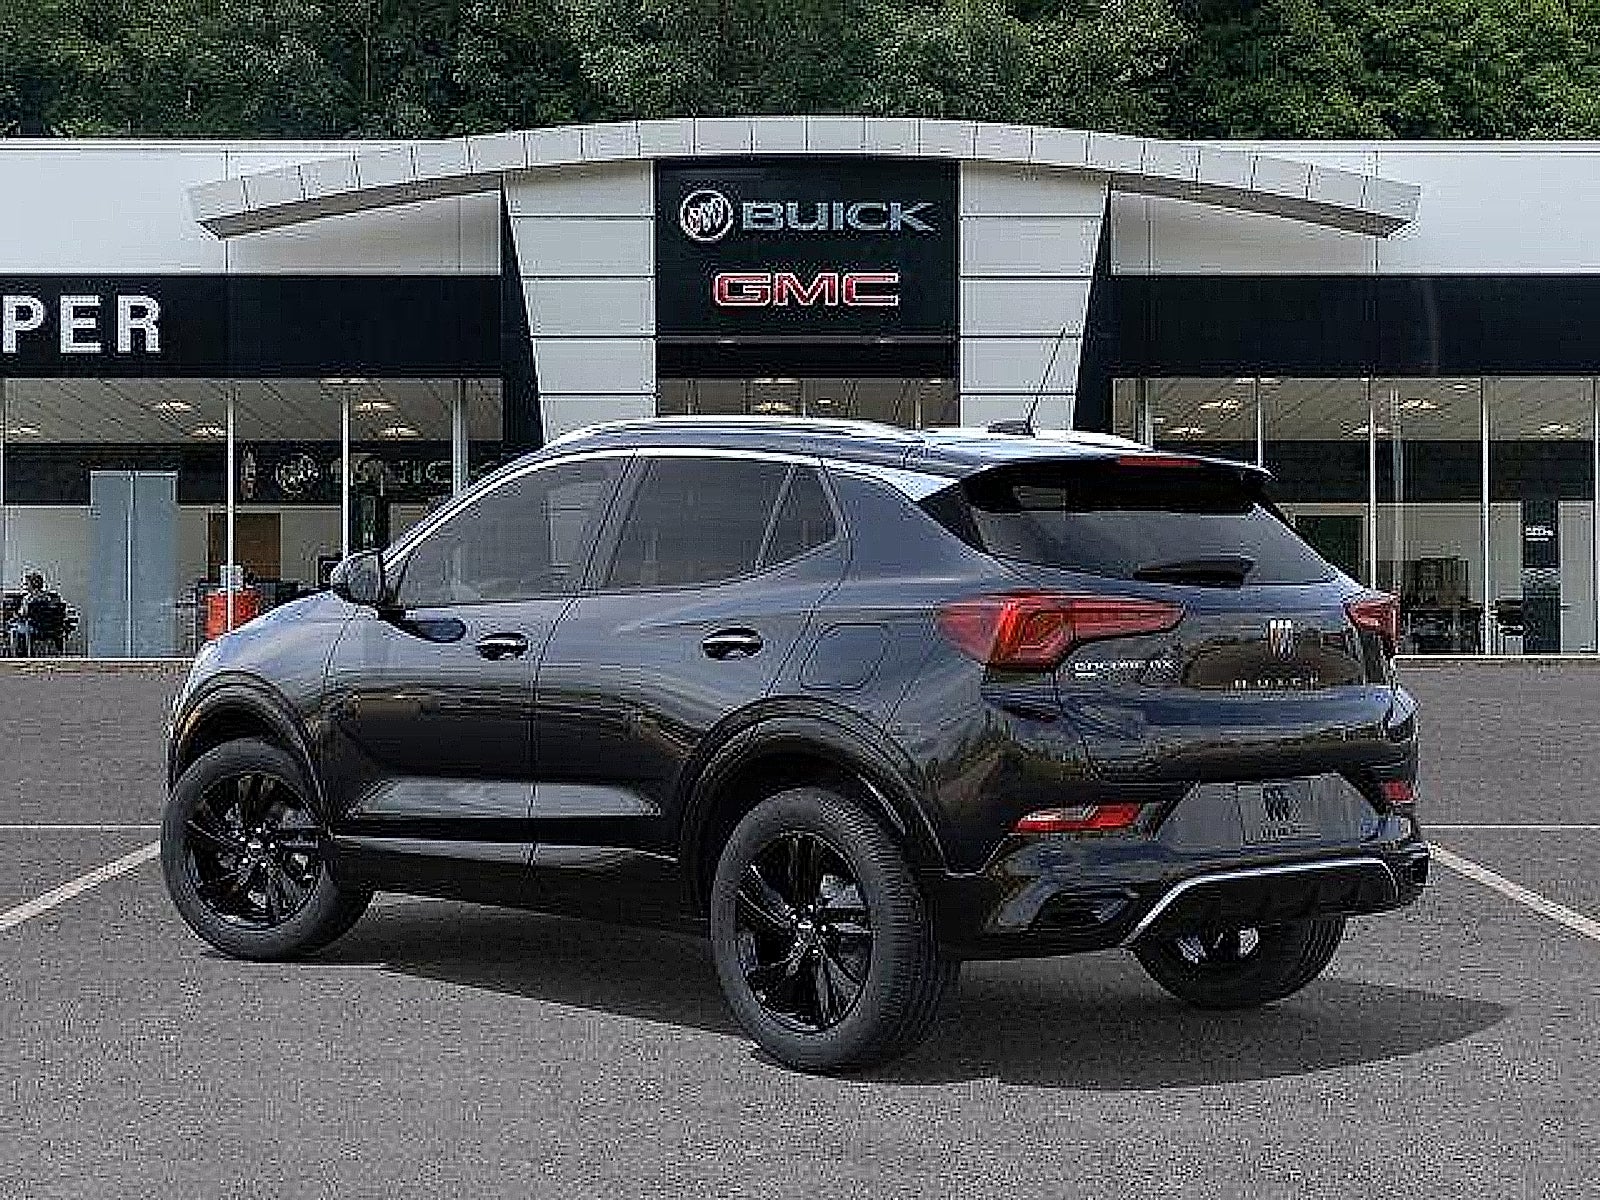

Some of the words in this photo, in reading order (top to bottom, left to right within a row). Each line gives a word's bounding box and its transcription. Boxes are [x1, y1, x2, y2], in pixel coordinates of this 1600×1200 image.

[742, 201, 935, 232] BUICK
[714, 271, 899, 307] GMC
[2, 295, 162, 353] PER
